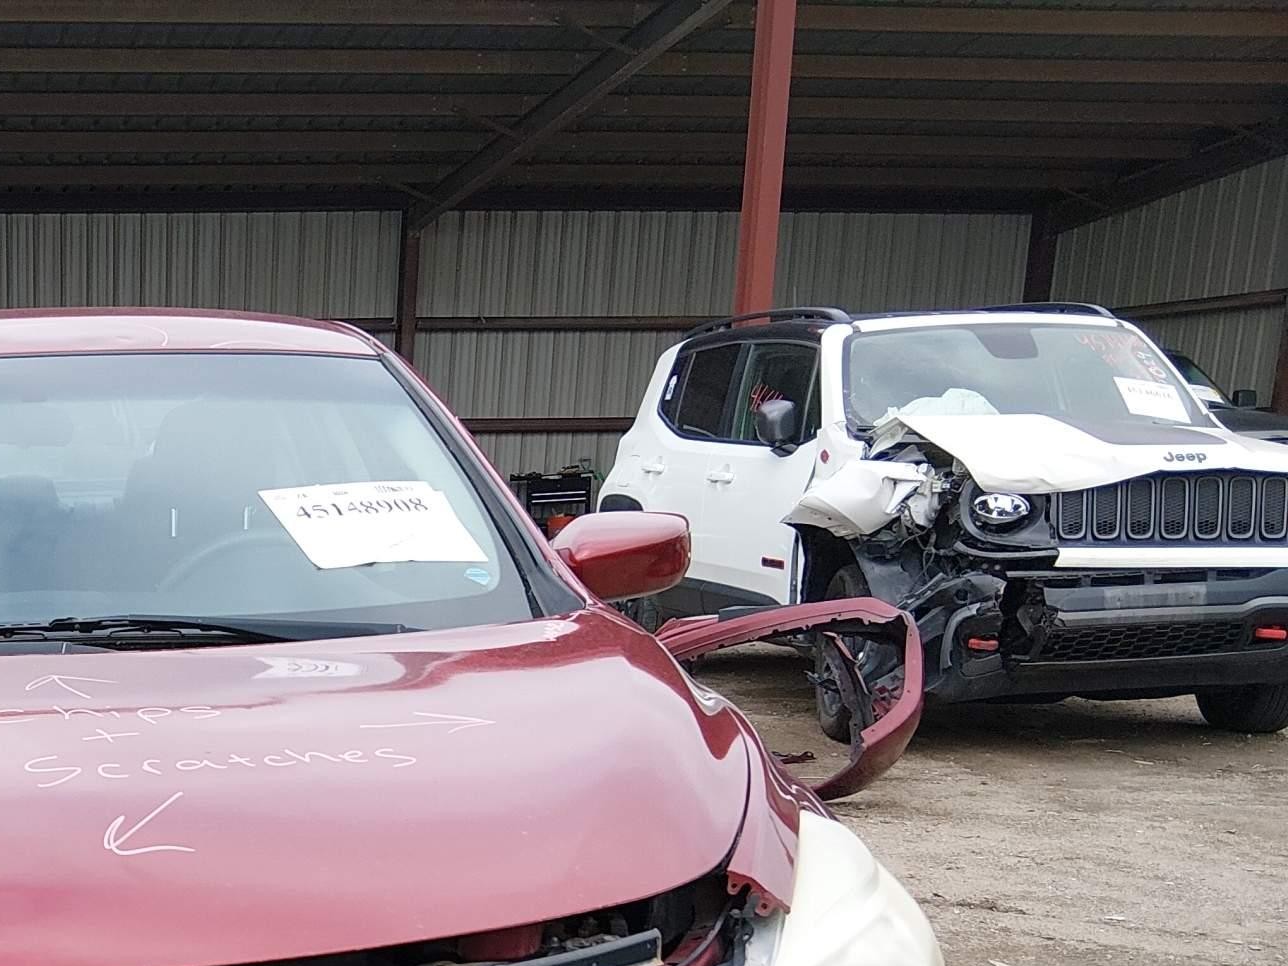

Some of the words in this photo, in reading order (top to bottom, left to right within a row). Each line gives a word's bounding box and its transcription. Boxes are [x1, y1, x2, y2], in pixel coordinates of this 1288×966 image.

[1163, 451, 1207, 464] Jeep
[296, 497, 428, 519] 45148908
[24, 746, 417, 788] Scratches
